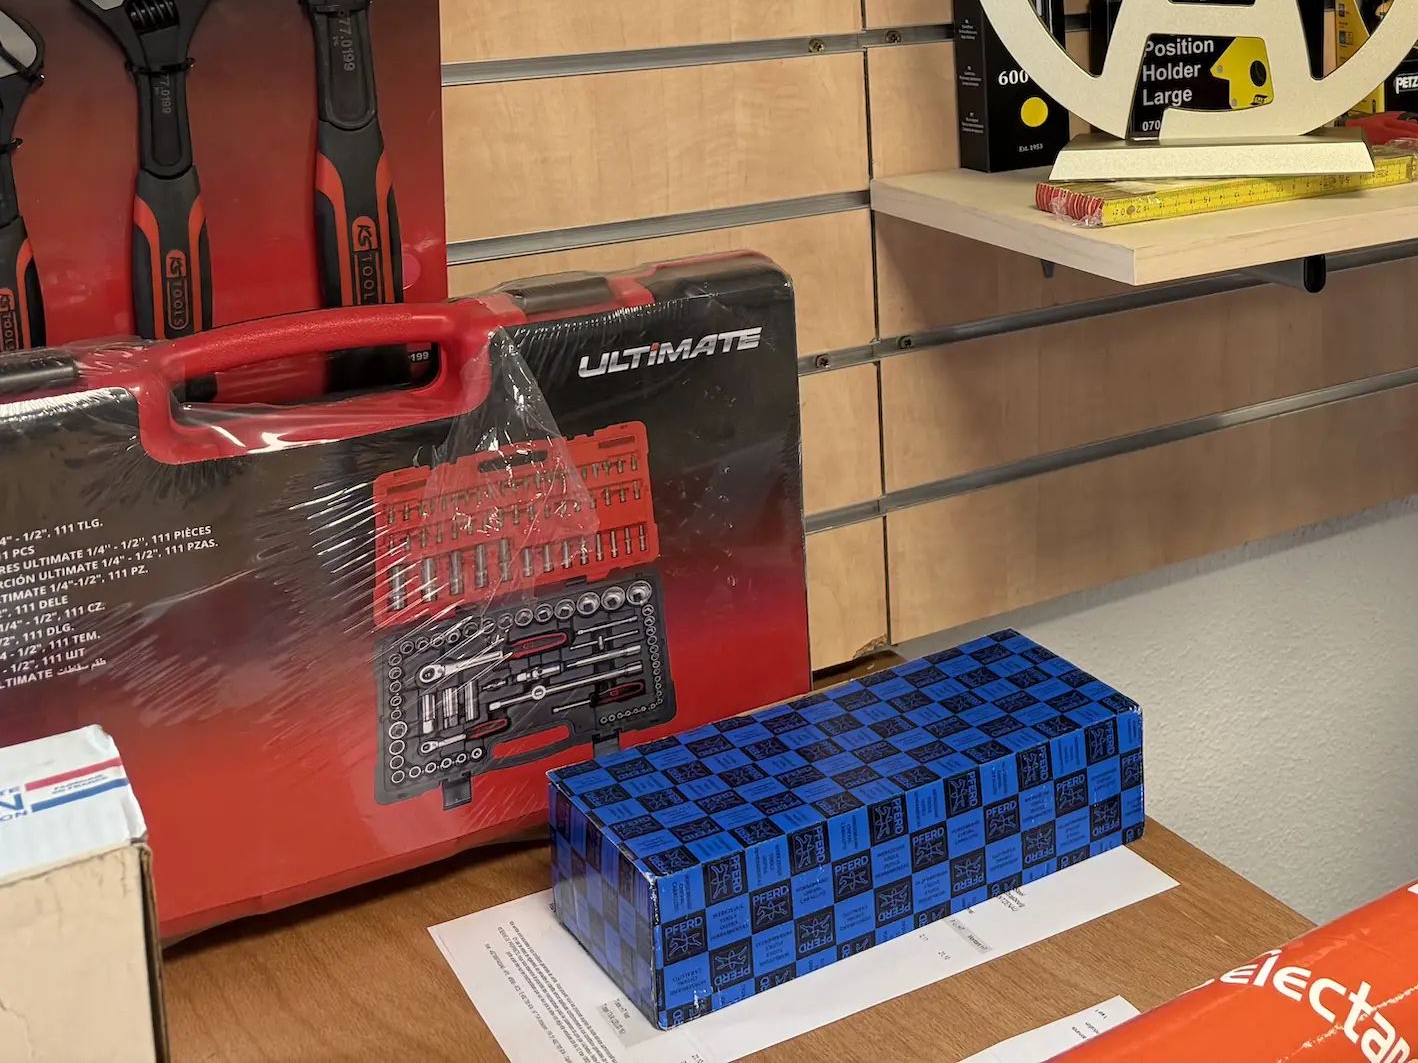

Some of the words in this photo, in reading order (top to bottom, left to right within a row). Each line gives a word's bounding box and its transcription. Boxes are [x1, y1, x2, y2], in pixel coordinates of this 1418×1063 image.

[1144, 37, 1215, 58] Position
[1142, 62, 1202, 83] Holder
[1142, 88, 1193, 107] Large
[361, 254, 373, 306] TOOL
[54, 524, 74, 535] 111
[77, 518, 103, 531] TLG.
[12, 545, 35, 559] PCS
[23, 551, 84, 570] ULTIMATE
[151, 532, 170, 544] 111
[174, 525, 212, 540] PIÈCES
[38, 561, 99, 581] ULTIMATE
[164, 544, 184, 555] 111
[187, 538, 219, 551] PZAS.
[0, 586, 47, 603] TIMATE
[108, 570, 128, 581] 111
[131, 565, 149, 576] PZ.
[15, 603, 35, 615] 111
[39, 595, 68, 609] DELE
[65, 606, 84, 618] 111
[87, 602, 105, 613] CZ.
[23, 628, 43, 640] 111
[46, 623, 74, 636] DLG.
[49, 638, 69, 649] 111
[72, 630, 100, 644] TEM.
[42, 653, 62, 665] 111
[1056, 774, 1086, 792] PFERD
[894, 798, 905, 835] PFERD
[986, 800, 1018, 818] PFERD
[816, 826, 827, 865] PFERD
[912, 826, 945, 848] PFERD
[730, 854, 744, 894] PFERD
[834, 855, 869, 874] PFERD
[954, 874, 985, 893] PFERD
[752, 885, 790, 905] PFERD
[878, 904, 913, 923] PFERD
[663, 916, 704, 936] PFERD
[798, 936, 834, 954] PFERD
[713, 967, 752, 987] PFERD
